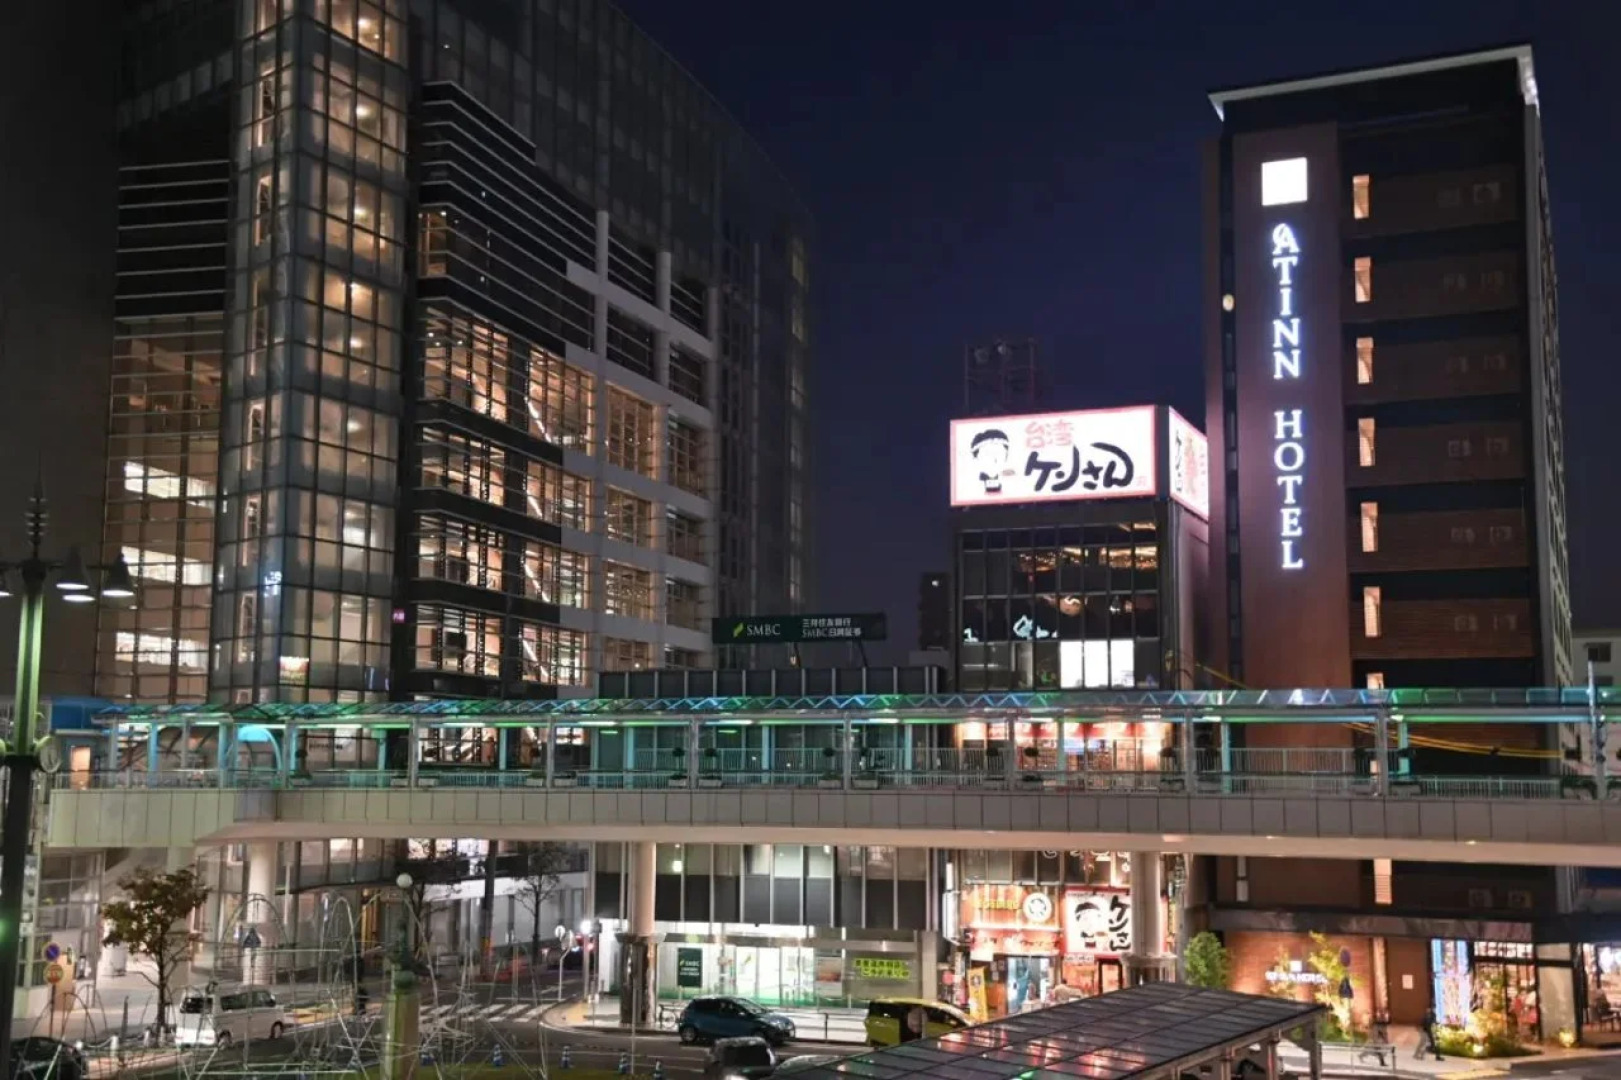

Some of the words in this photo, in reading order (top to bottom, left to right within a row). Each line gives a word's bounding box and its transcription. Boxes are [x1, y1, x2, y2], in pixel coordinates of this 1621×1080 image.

[1024, 442, 1134, 492] ケンさん
[1273, 409, 1304, 569] HOTEL
[746, 623, 781, 636] SMBC
[1108, 894, 1132, 952] ケンさん
